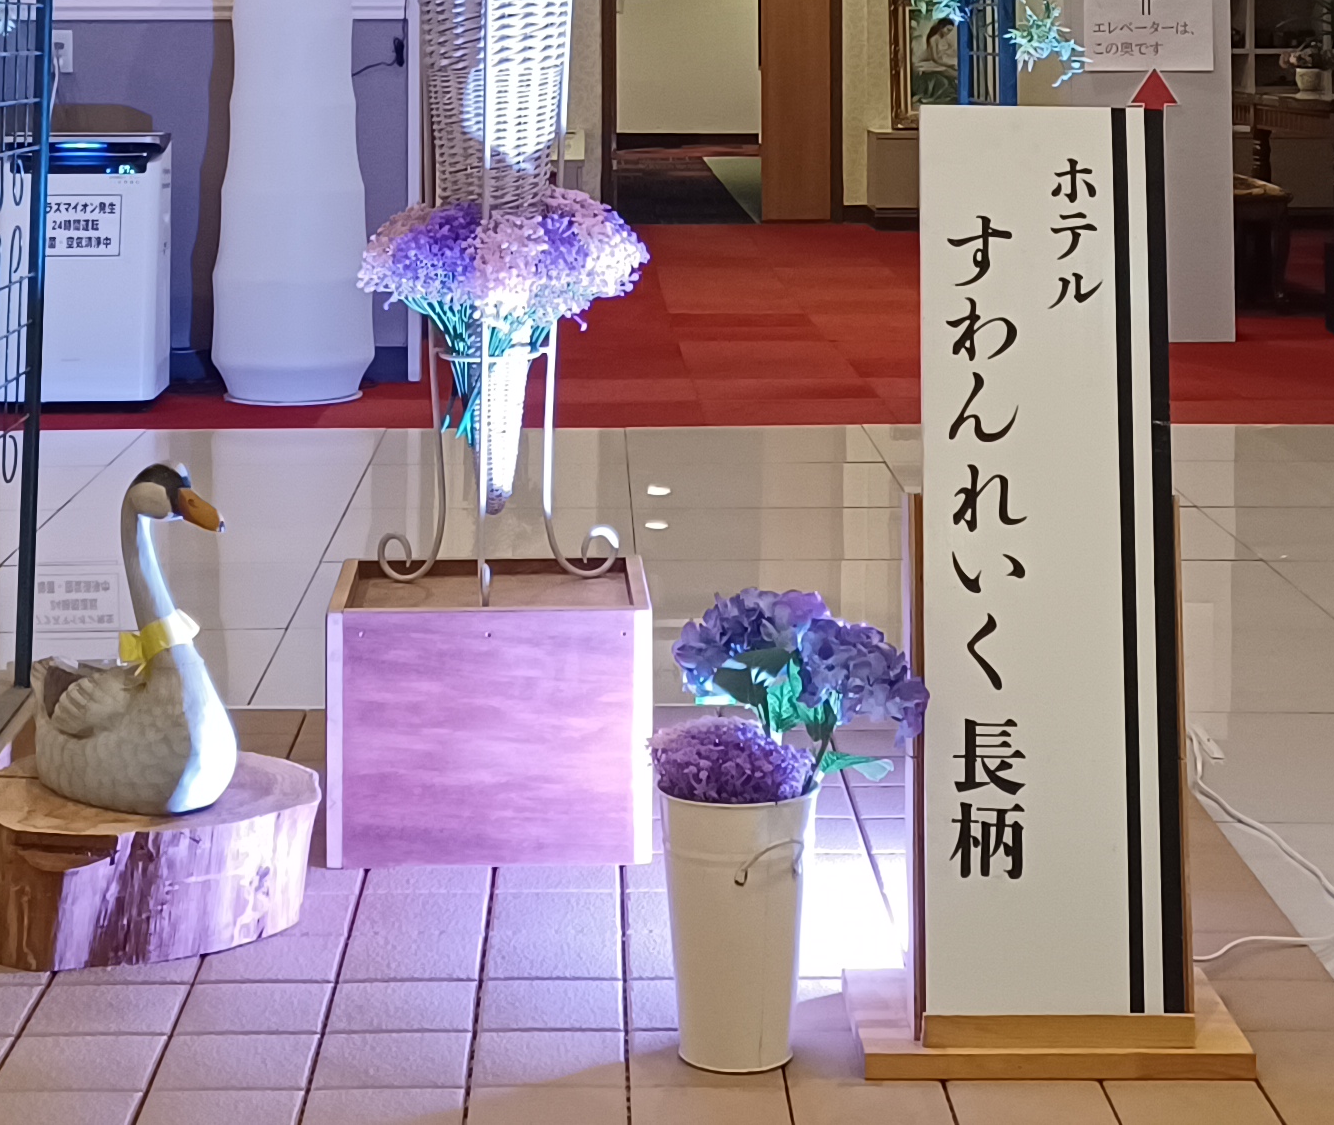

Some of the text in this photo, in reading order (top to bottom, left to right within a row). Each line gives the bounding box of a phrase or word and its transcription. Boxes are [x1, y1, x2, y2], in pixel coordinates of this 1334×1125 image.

[1092, 21, 1195, 36] エレベーターは、
[1092, 41, 1164, 56] この奥です
[46, 201, 116, 214] ラズマイオン発生
[1047, 158, 1104, 309] ホテル
[47, 236, 112, 249] 菌・空気清浄中
[945, 215, 1028, 880] すわんれいく長柄
